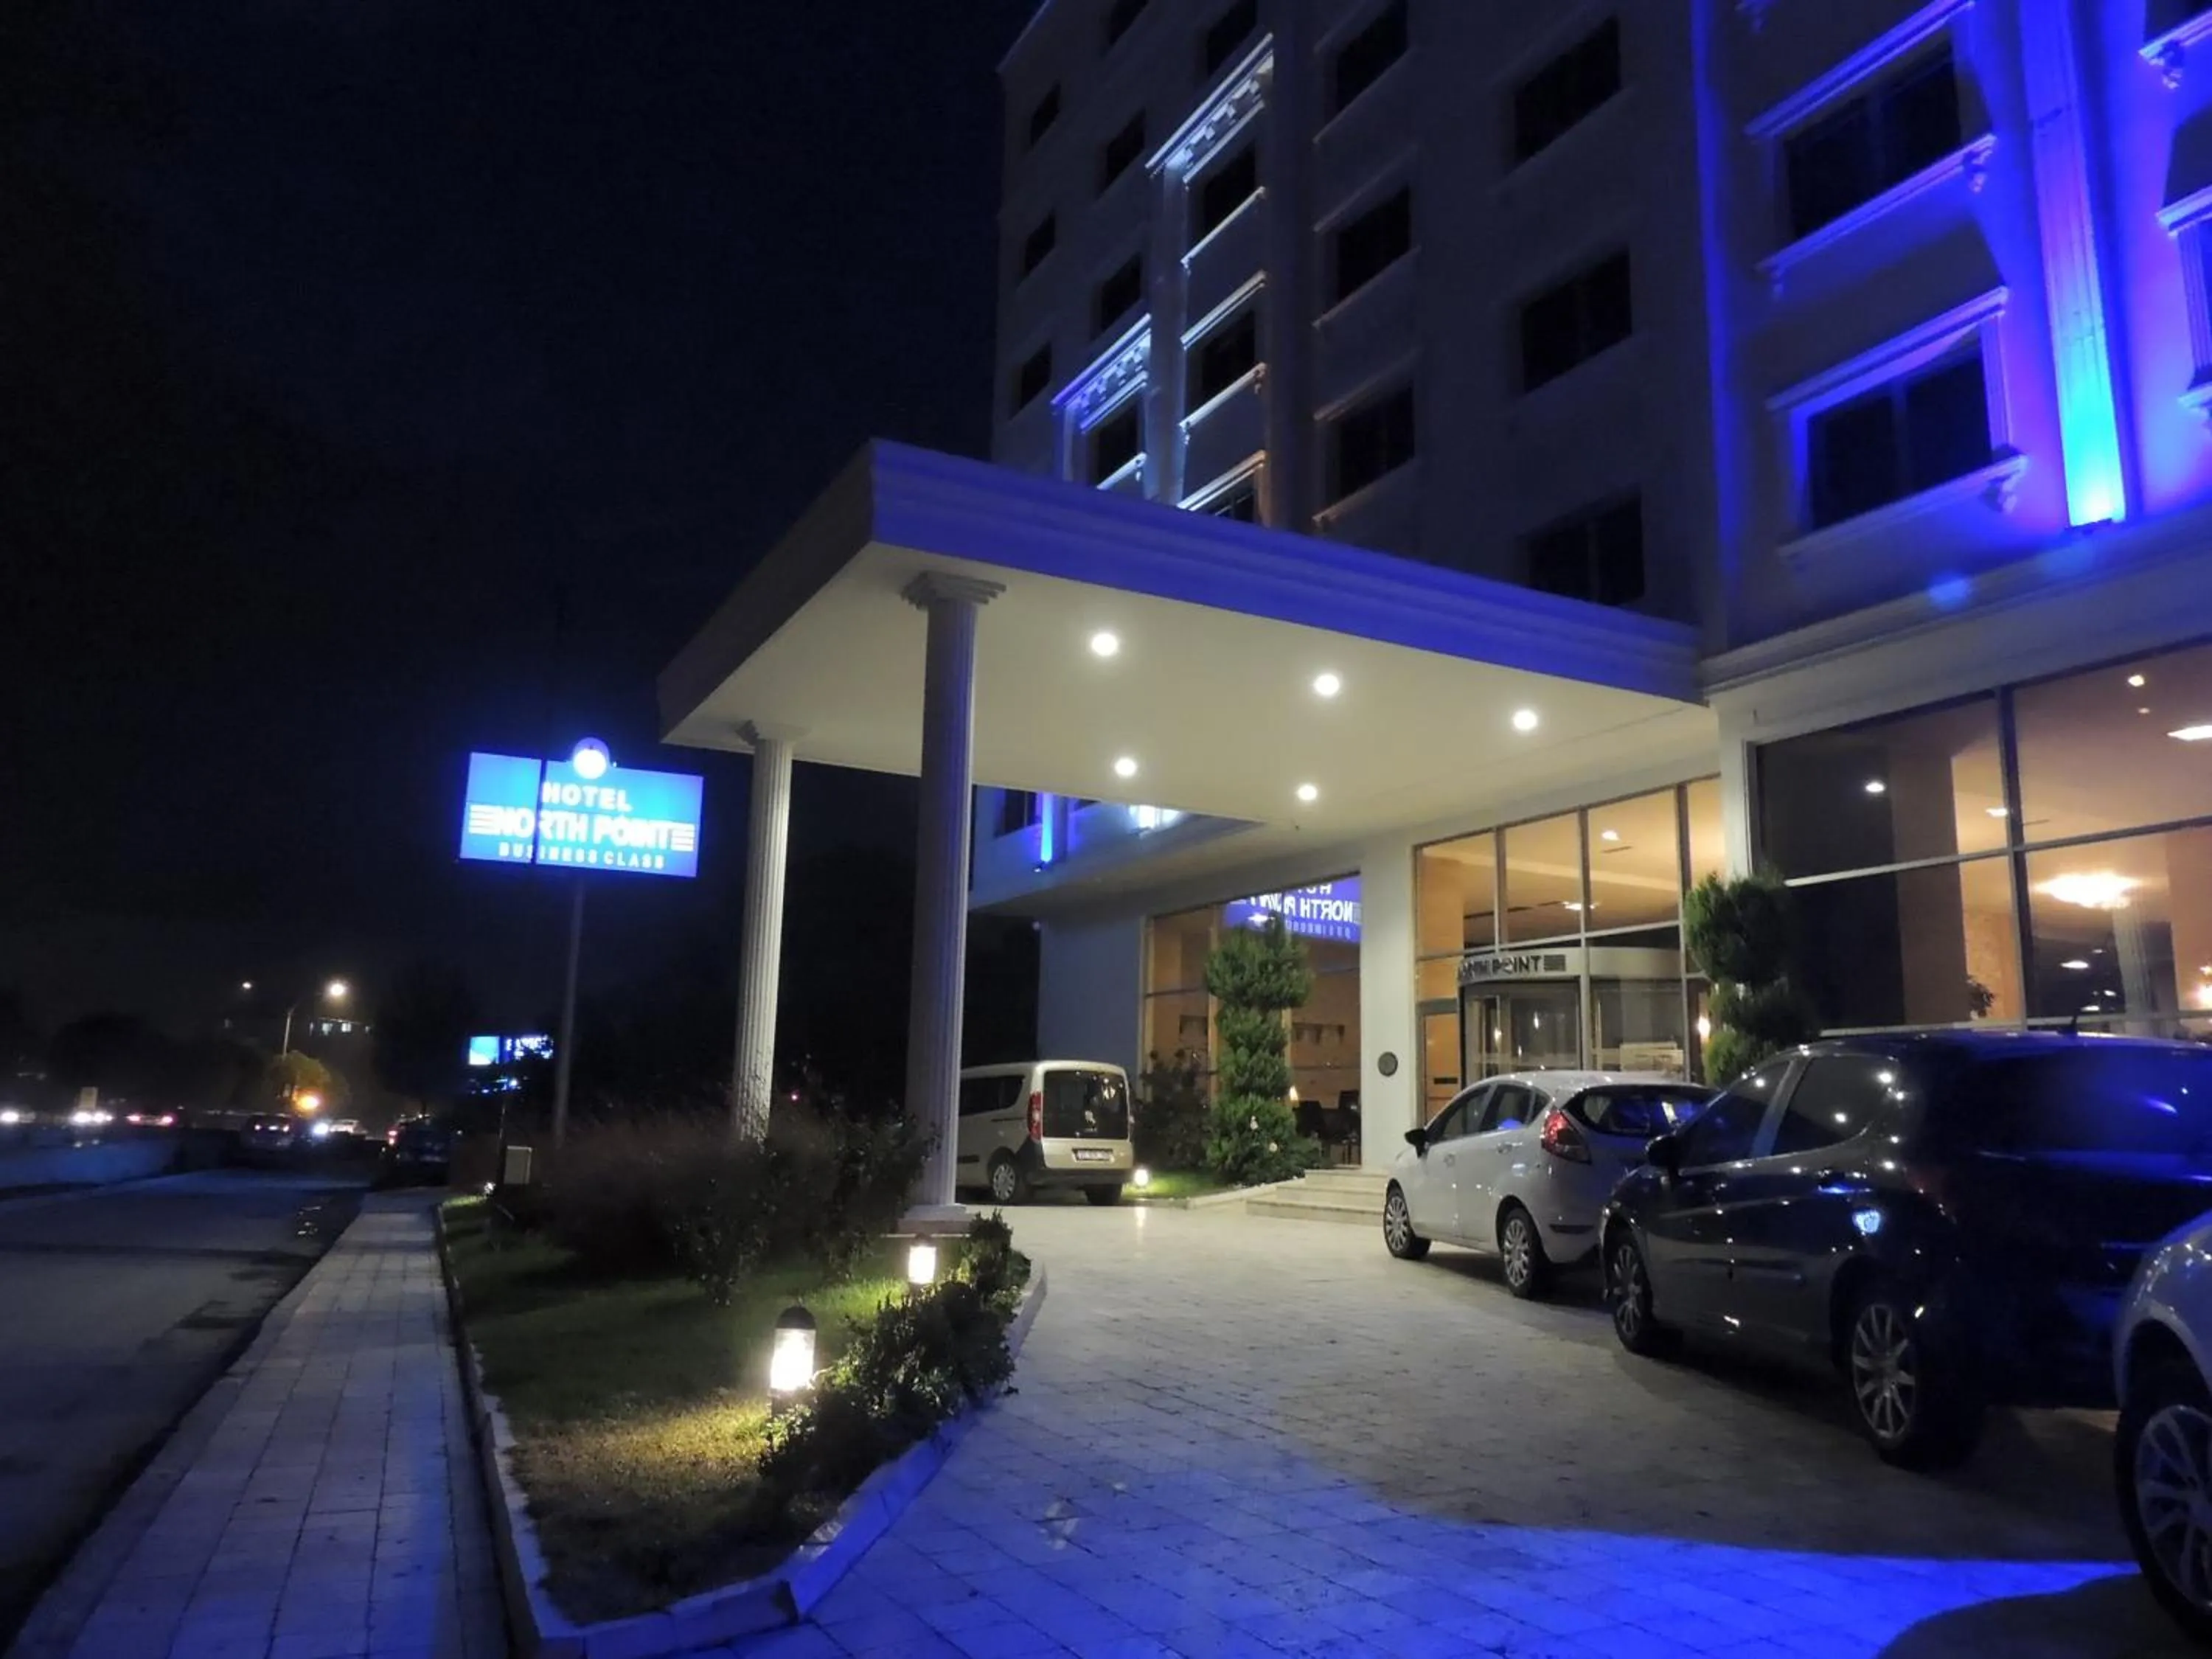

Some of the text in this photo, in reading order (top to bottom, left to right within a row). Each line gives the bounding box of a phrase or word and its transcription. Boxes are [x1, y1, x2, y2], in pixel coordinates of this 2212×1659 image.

[542, 782, 633, 812] HOTEL
[501, 806, 672, 850] NORTH POINT
[603, 849, 664, 869] CLASS
